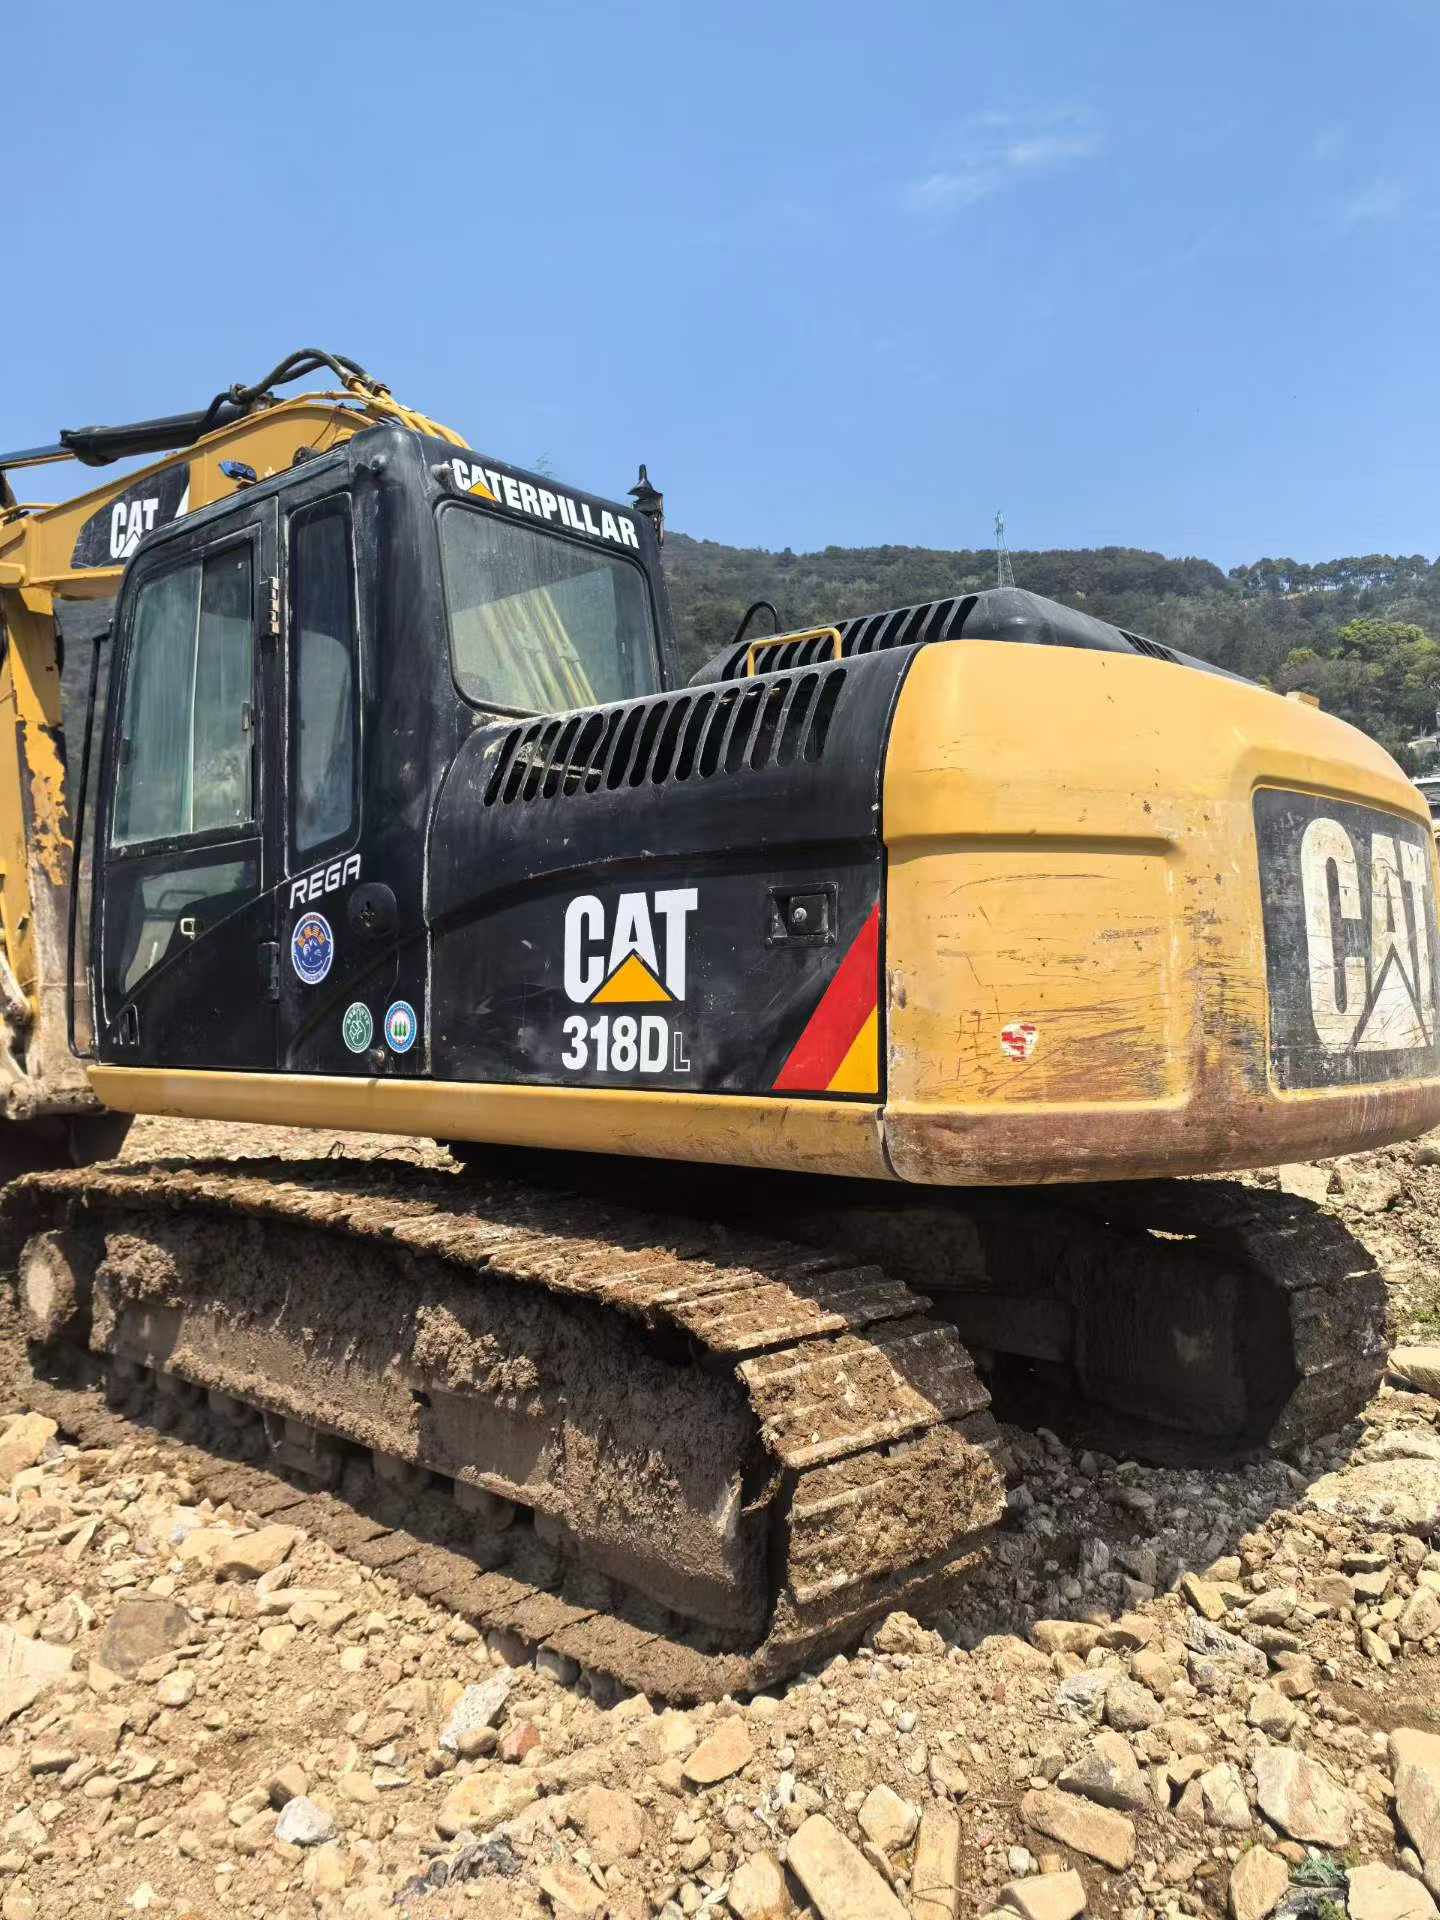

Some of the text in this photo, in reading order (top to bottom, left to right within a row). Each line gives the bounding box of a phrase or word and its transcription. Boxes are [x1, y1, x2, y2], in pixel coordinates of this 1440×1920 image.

[110, 498, 159, 558] CAT
[451, 458, 640, 549] CATERPILLAR
[289, 853, 361, 909] REGA
[563, 888, 699, 1004] CAT
[1301, 817, 1434, 1054] CAT
